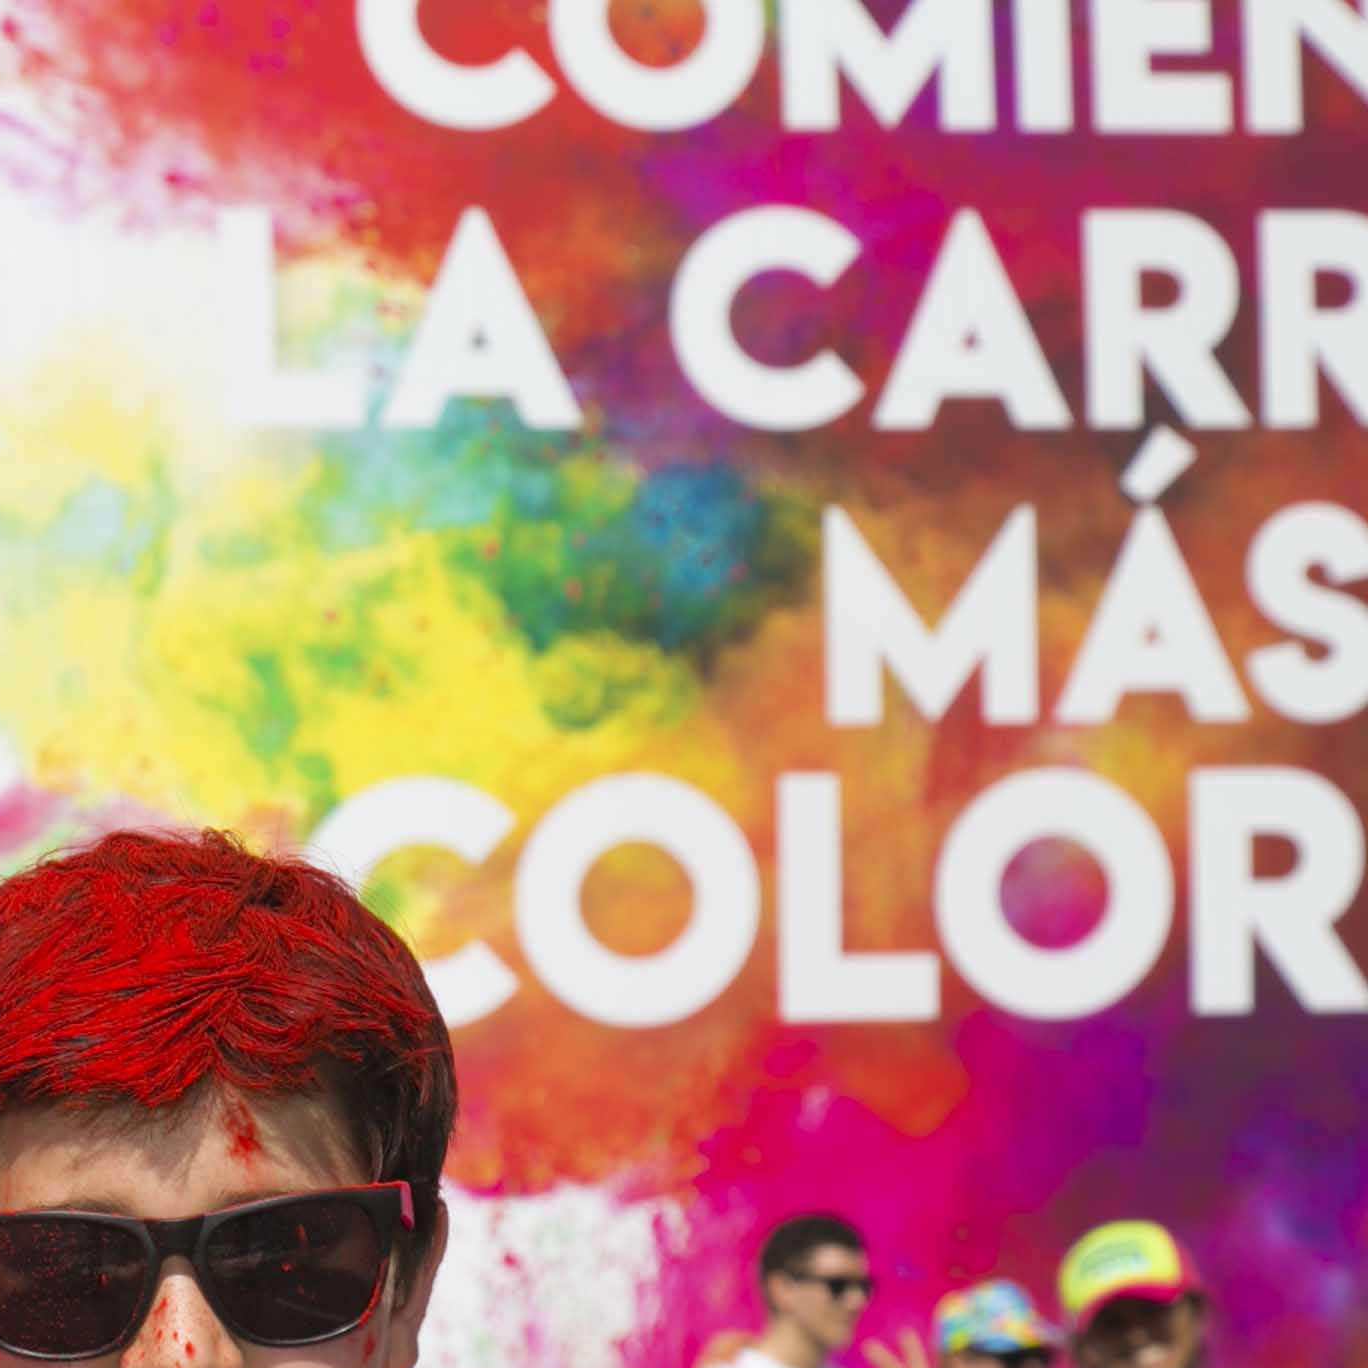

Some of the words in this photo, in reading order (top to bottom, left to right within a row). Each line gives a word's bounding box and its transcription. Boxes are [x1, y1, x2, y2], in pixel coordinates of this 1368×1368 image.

[216, 203, 583, 431] LA
[667, 203, 1368, 431] CARR
[821, 424, 1368, 726] MÁS
[310, 767, 1368, 1028] COLOR
